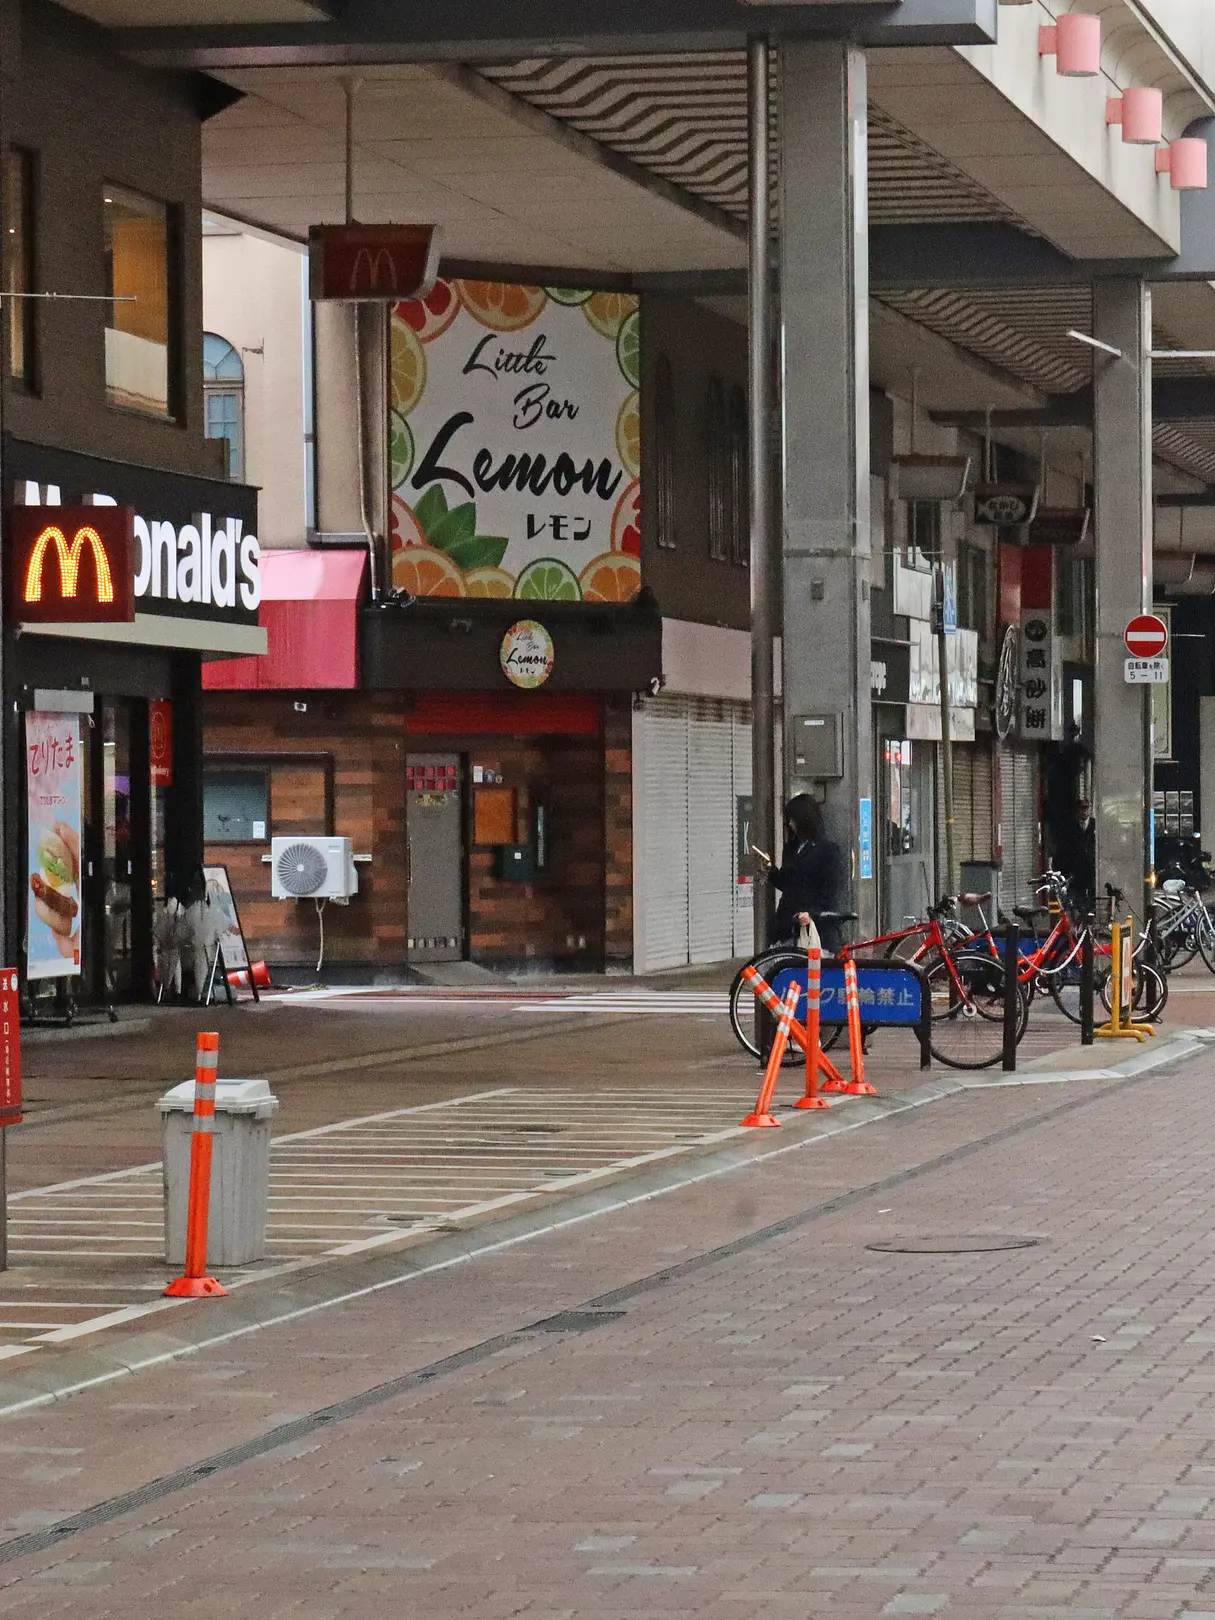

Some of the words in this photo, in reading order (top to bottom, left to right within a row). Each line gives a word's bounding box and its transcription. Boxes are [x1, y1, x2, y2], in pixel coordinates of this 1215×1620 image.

[462, 333, 557, 380] Little
[513, 383, 580, 430] Bar
[411, 411, 623, 500] Lemon
[25, 480, 261, 610] onald's
[526, 513, 592, 541] レモン
[505, 647, 549, 666] Lemon
[1128, 661, 1165, 670] 自転車を除く
[30, 732, 75, 775] てりたま
